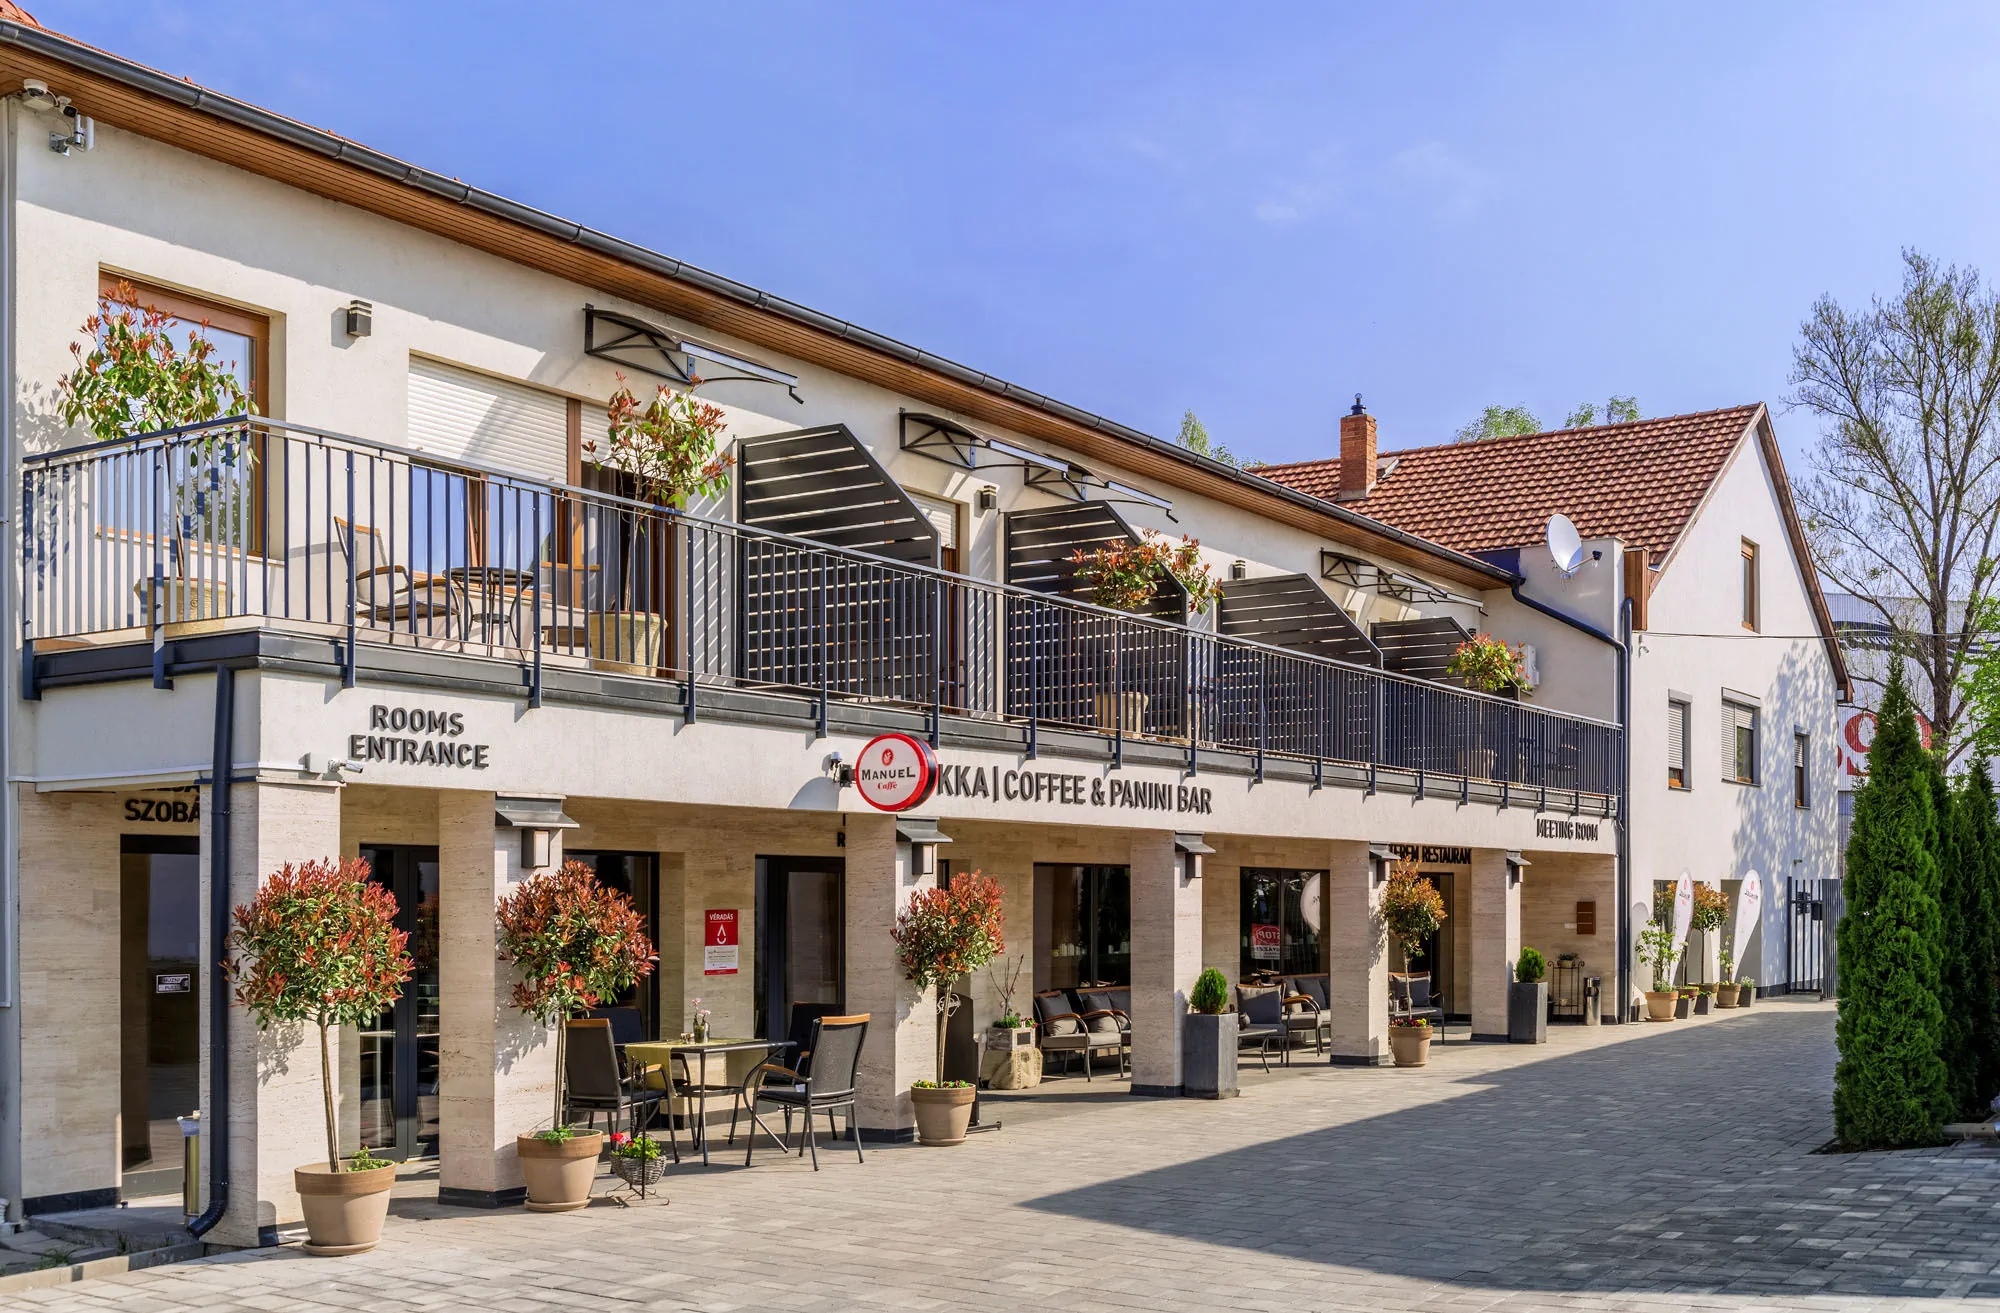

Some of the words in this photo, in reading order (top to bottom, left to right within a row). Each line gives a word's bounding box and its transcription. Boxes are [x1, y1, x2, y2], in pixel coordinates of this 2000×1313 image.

[370, 704, 464, 737] ROOMS
[348, 734, 490, 771] ENTRANCE
[861, 766, 916, 780] MANUEL
[1004, 769, 1086, 805] COFFEE
[1090, 777, 1106, 807] &
[1109, 778, 1173, 812] PANINI
[1177, 785, 1212, 815] BAR
[1536, 818, 1574, 840] MEETING
[1575, 821, 1599, 841] ROOM
